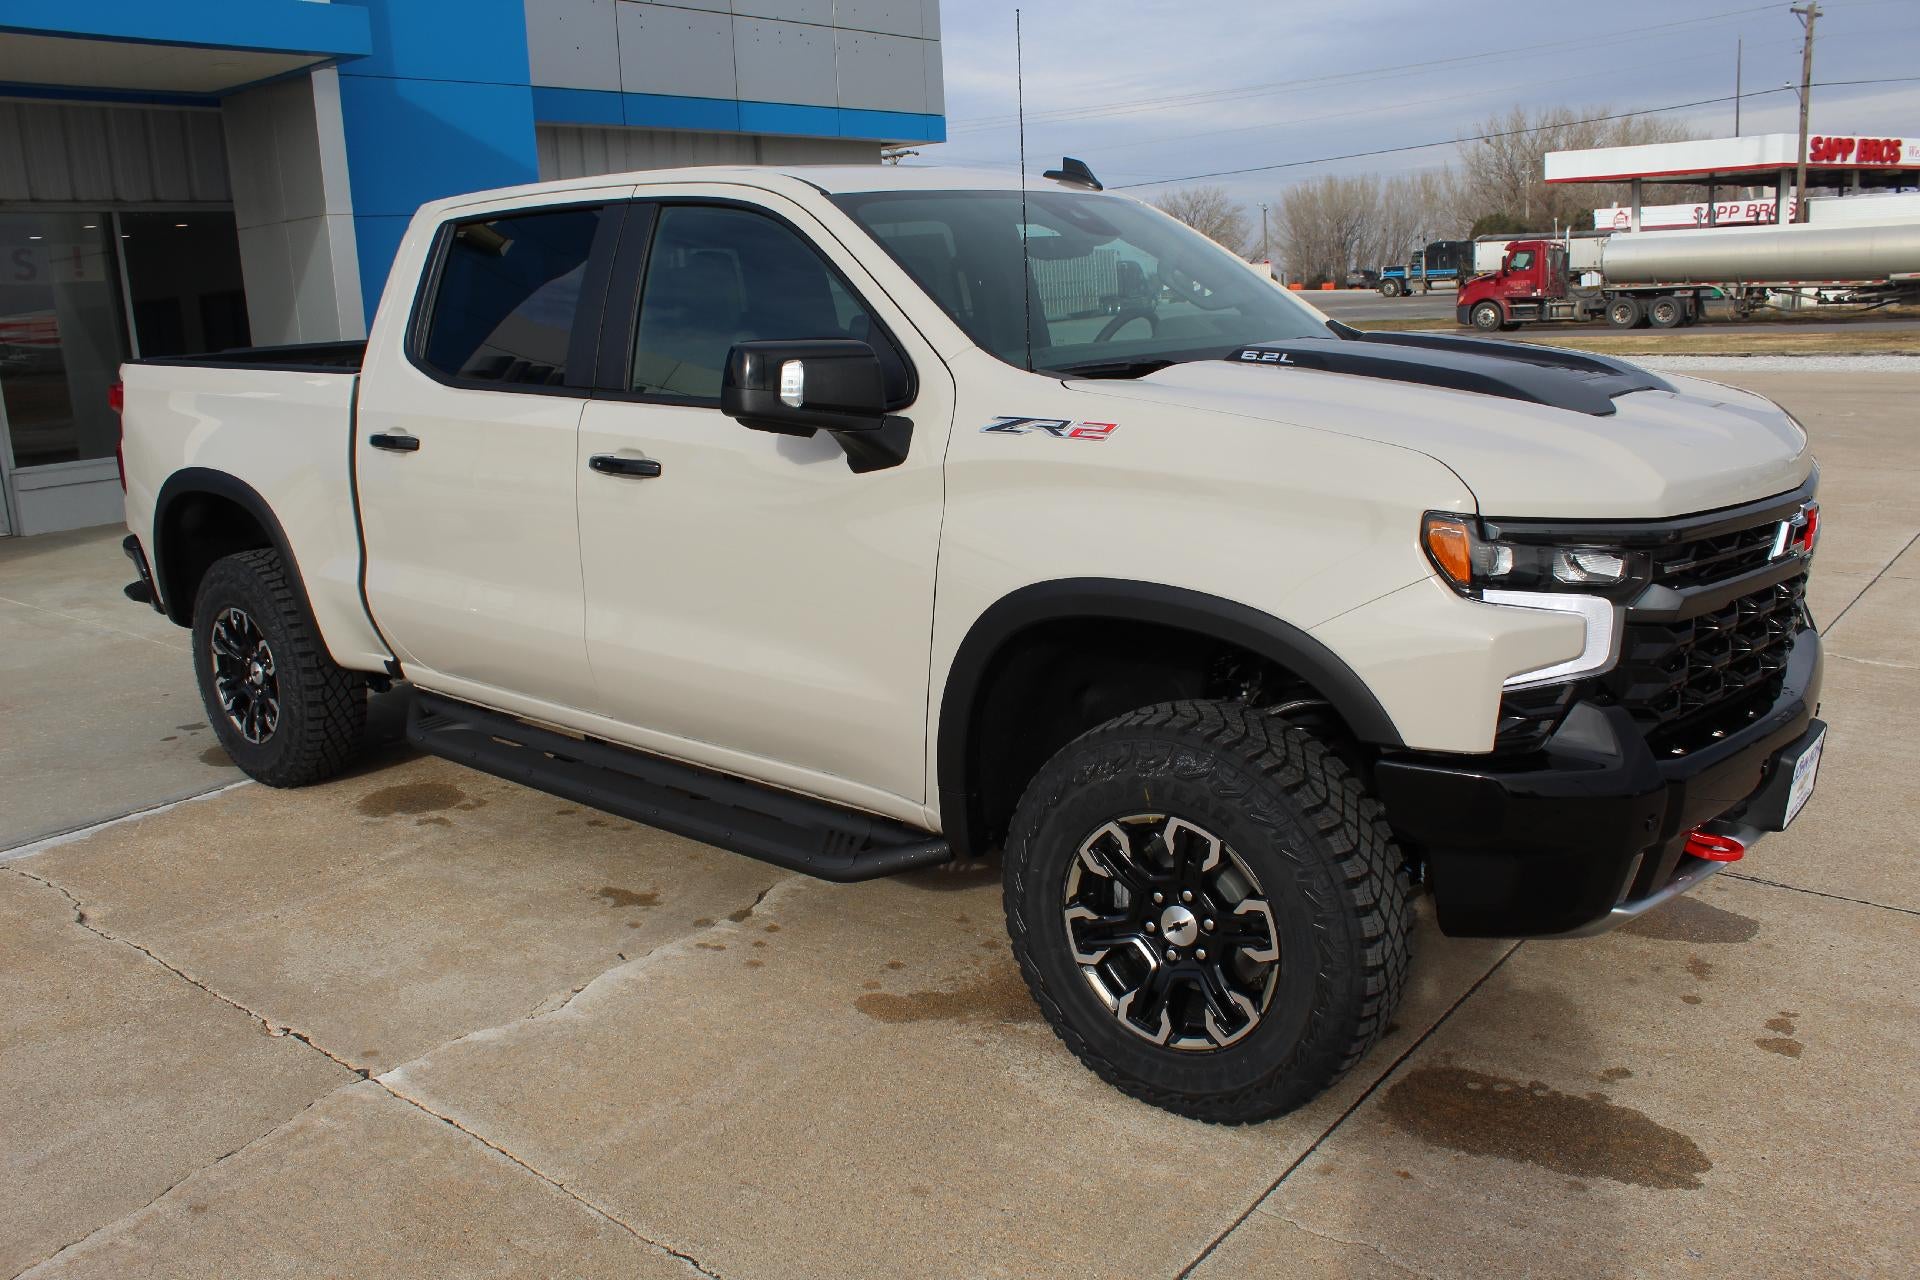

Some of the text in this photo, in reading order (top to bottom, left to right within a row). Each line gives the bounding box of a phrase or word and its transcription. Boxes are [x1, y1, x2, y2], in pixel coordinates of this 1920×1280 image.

[1809, 136, 1902, 164] SAPP BROS
[1241, 350, 1295, 364] 6.2L
[979, 415, 1121, 441] ZR2
